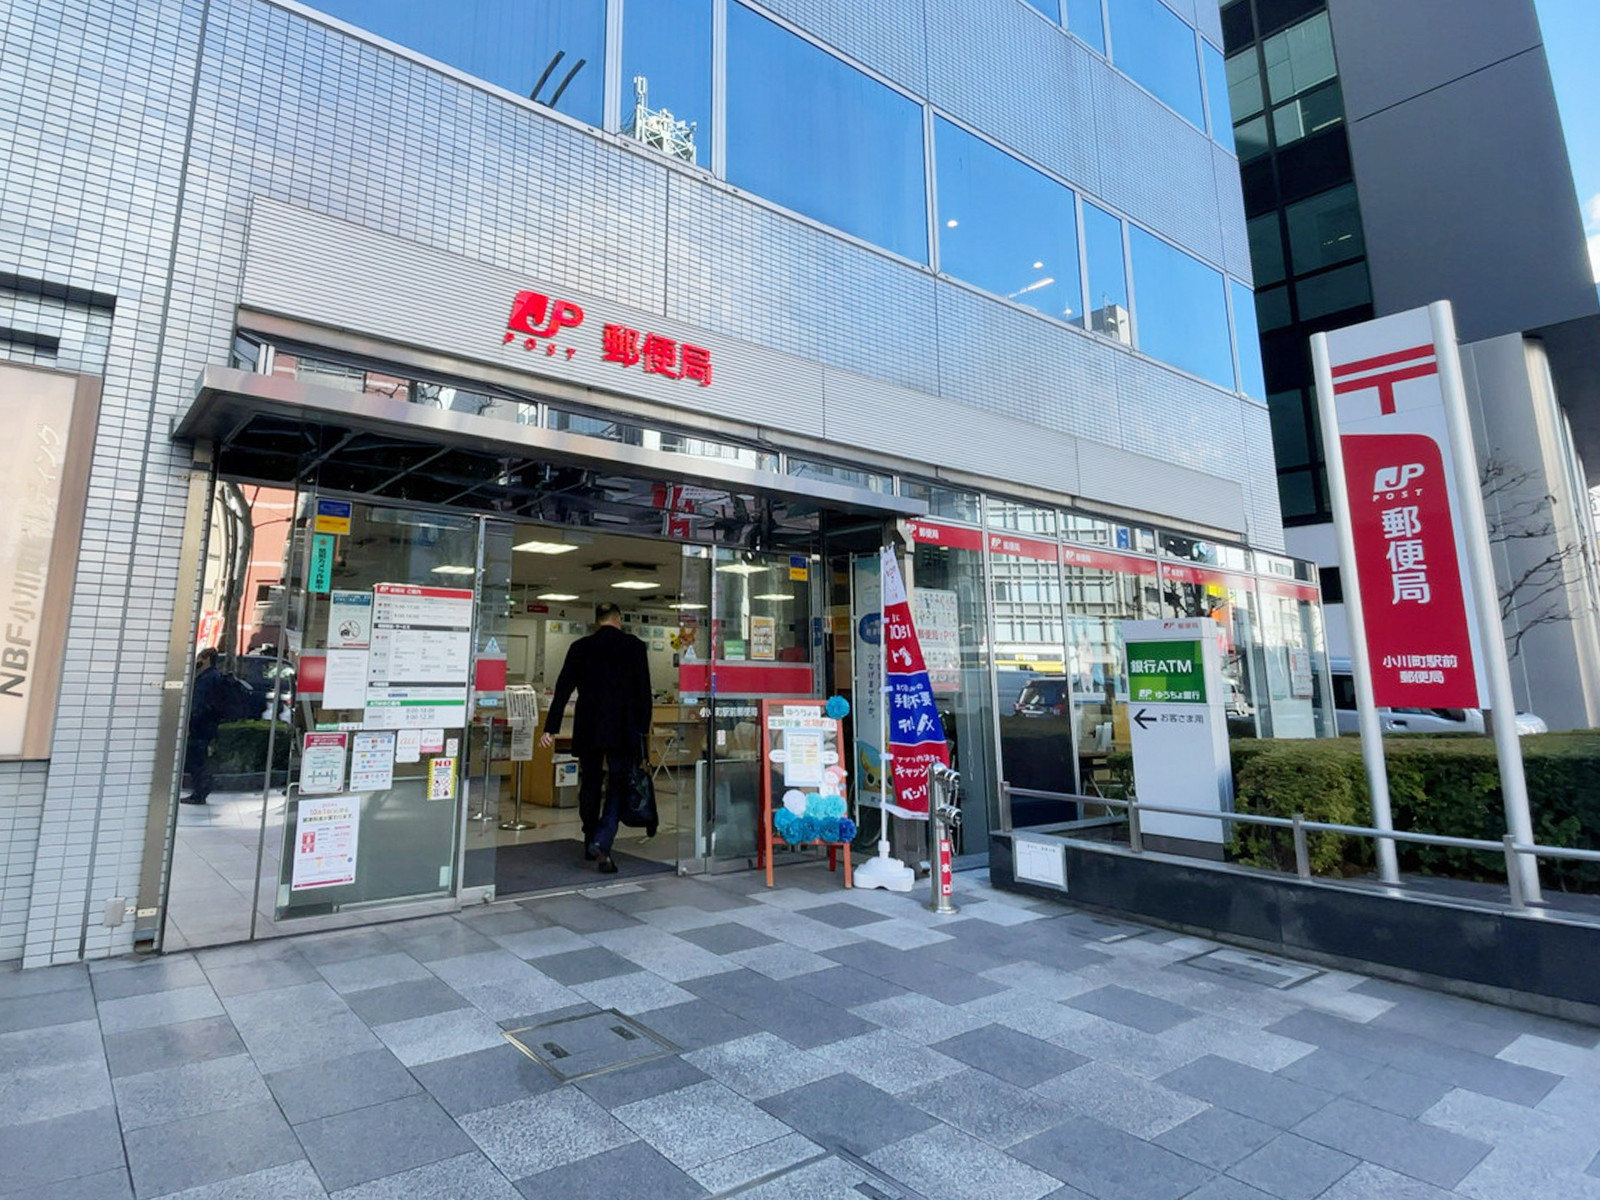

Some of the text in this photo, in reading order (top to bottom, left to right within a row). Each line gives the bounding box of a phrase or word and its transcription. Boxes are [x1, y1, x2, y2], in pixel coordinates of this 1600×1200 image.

[503, 331, 576, 360] POST
[602, 322, 712, 387] 郵便局
[1372, 489, 1423, 501] POST
[1381, 506, 1431, 606] 郵便局
[1130, 659, 1193, 673] 銀行ATM
[1382, 655, 1458, 669] 小川町駅前
[1400, 670, 1444, 684] 郵便局
[1155, 689, 1200, 700] ゆうちょ銀行
